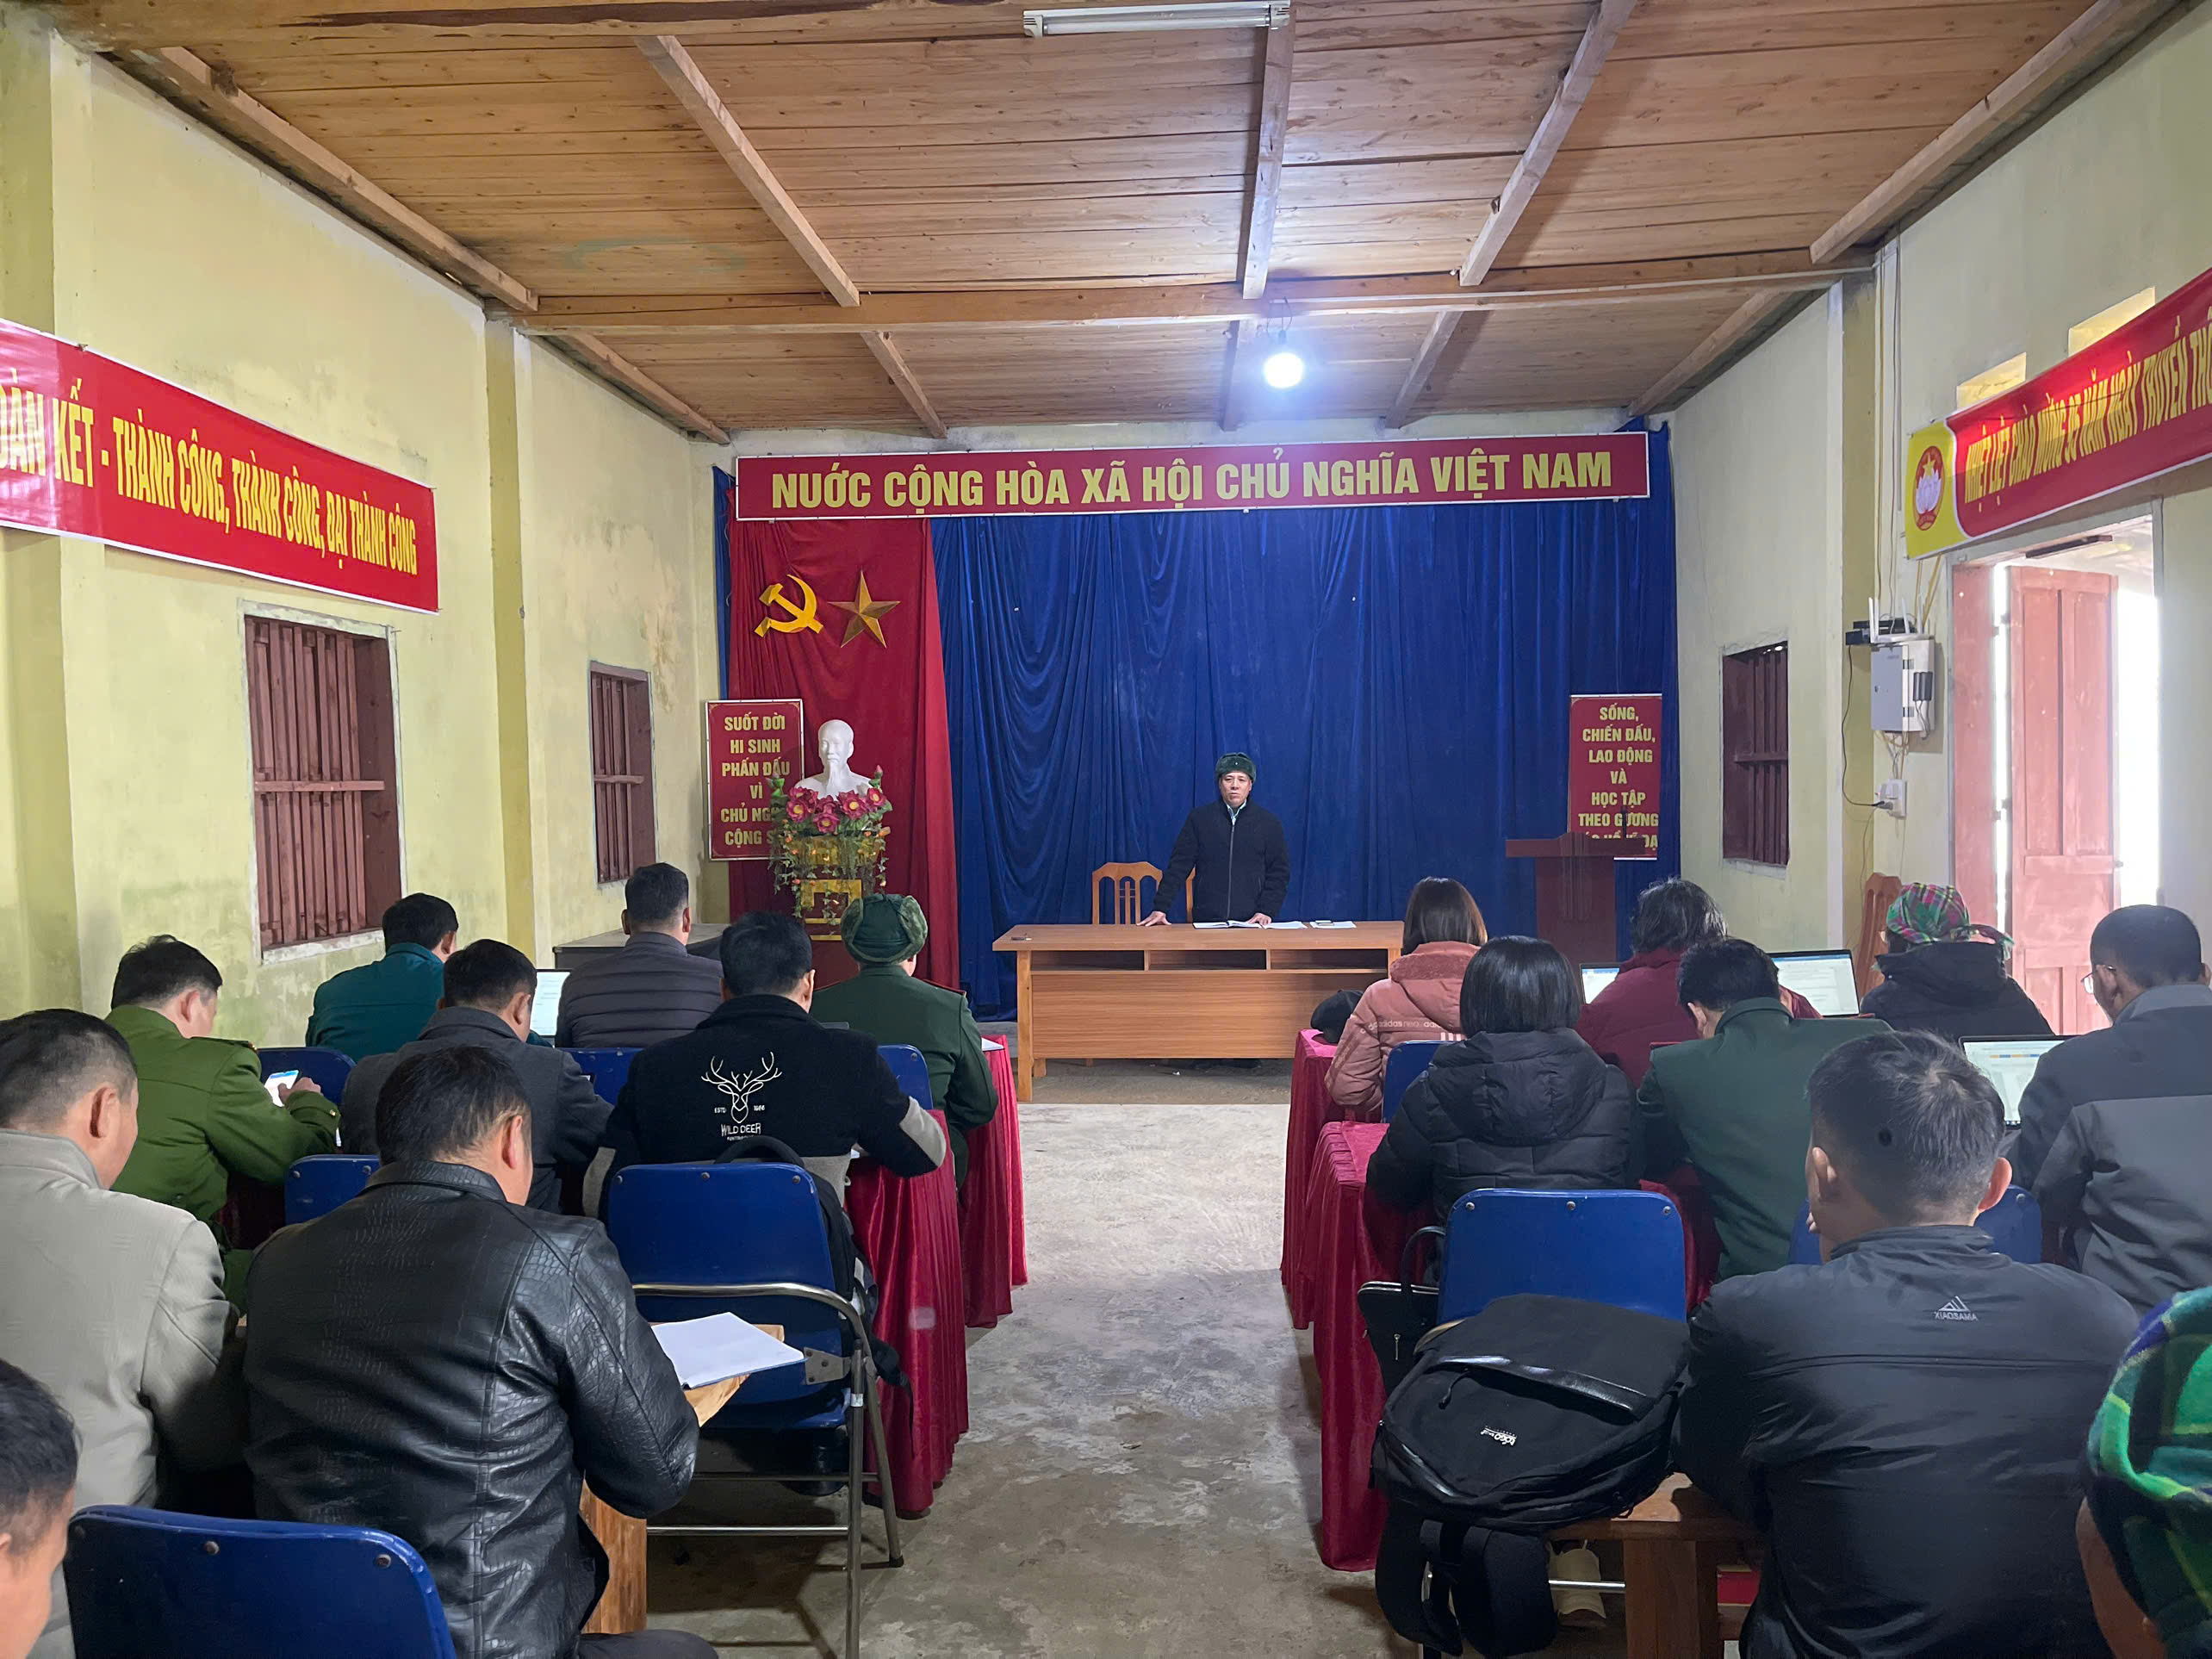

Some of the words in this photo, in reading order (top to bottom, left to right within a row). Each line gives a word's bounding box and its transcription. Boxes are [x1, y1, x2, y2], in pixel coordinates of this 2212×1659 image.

[1965, 425, 1991, 513] NHIỆT
[1989, 414, 2010, 506] LIỆT
[2009, 404, 2035, 487] CHÀO
[2034, 392, 2066, 476] MỪNG
[2064, 393, 2081, 463] 95
[2079, 368, 2109, 457] NĂM
[2108, 351, 2141, 445] NGÀY
[2141, 315, 2188, 431] TRUYỀN
[53, 378, 94, 488] KẾT
[113, 408, 176, 510] THÀNH
[177, 428, 230, 534] CÔNG,
[232, 450, 282, 538] THÀNH
[283, 465, 325, 558] CÔNG,
[326, 490, 348, 569] ĐẠI
[349, 491, 388, 568] THÀNH
[388, 502, 418, 575] CÔNG
[884, 463, 984, 514] CỘNG
[996, 461, 1070, 506] HÒA
[1081, 460, 1131, 504] XÃ
[1142, 458, 1203, 509] HỘI
[1216, 447, 1289, 500] CHỦ
[1302, 451, 1420, 497] NGHĨA
[1430, 447, 1510, 499] VIỆT
[1523, 451, 1612, 489] NAM
[724, 711, 759, 730] SUỐT
[762, 711, 786, 730] ĐỜI
[1600, 702, 1639, 722] SỐNG,
[1582, 724, 1622, 743] CHIẾN
[1625, 724, 1656, 743] ĐẤU,
[730, 739, 744, 754] HI
[748, 738, 780, 754] SINH
[1588, 749, 1613, 763] LAO
[1617, 747, 1653, 766] ĐỘNG
[722, 757, 759, 777] PHẤN
[762, 756, 791, 777] ĐẤU
[1610, 768, 1627, 785] VÀ
[749, 781, 763, 799] VÌ
[1592, 792, 1618, 809] HỌC
[1621, 789, 1646, 809] TẬP
[720, 802, 749, 823] CHỦ
[1578, 813, 1611, 827] THEO
[724, 828, 762, 848] CỘNG
[721, 1123, 739, 1137] WILD
[740, 1122, 761, 1134] DEER
